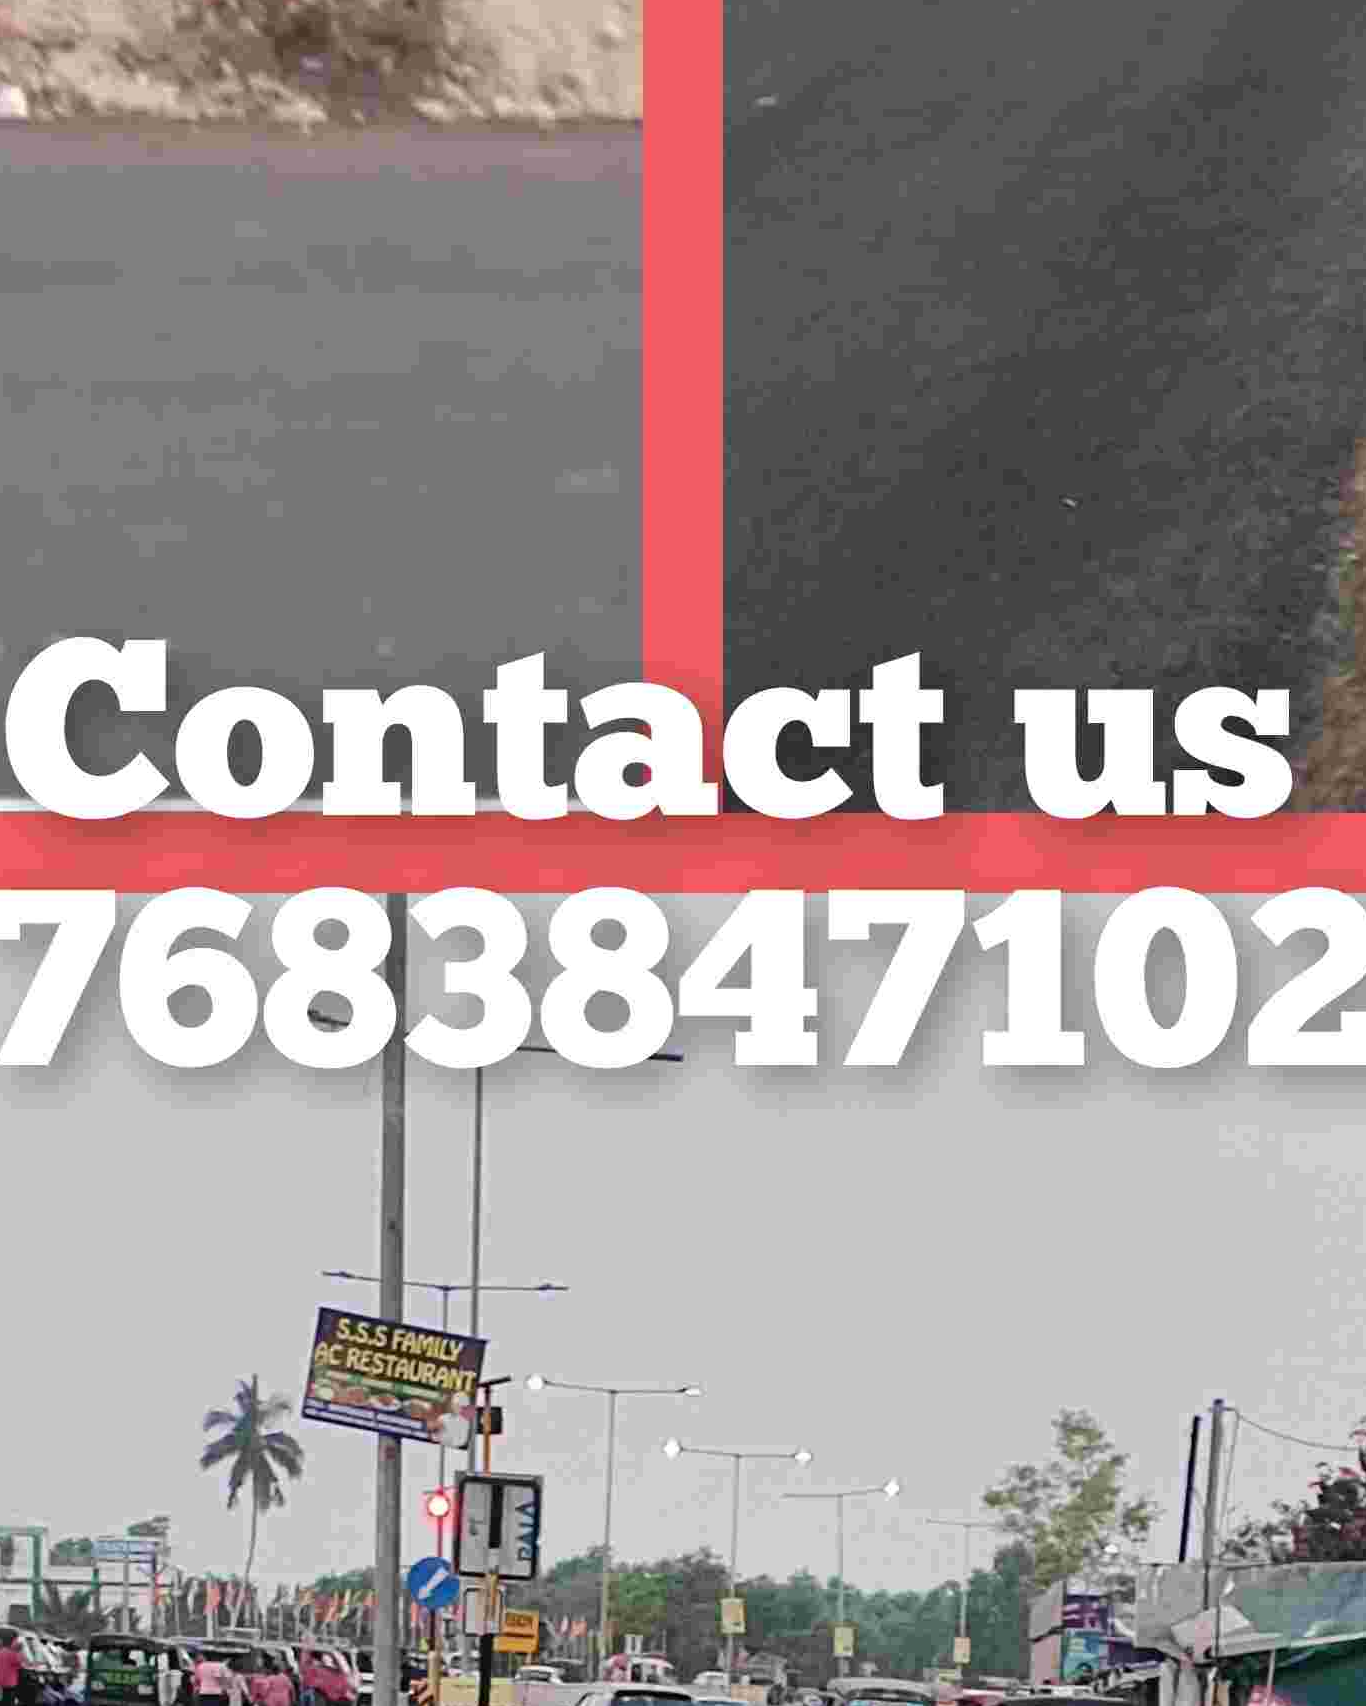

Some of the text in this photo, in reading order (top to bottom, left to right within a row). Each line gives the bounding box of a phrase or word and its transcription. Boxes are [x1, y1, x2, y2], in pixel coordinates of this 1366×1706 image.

[314, 1341, 477, 1391] AC RESTAURANT
[390, 1327, 464, 1363] FAMILY
